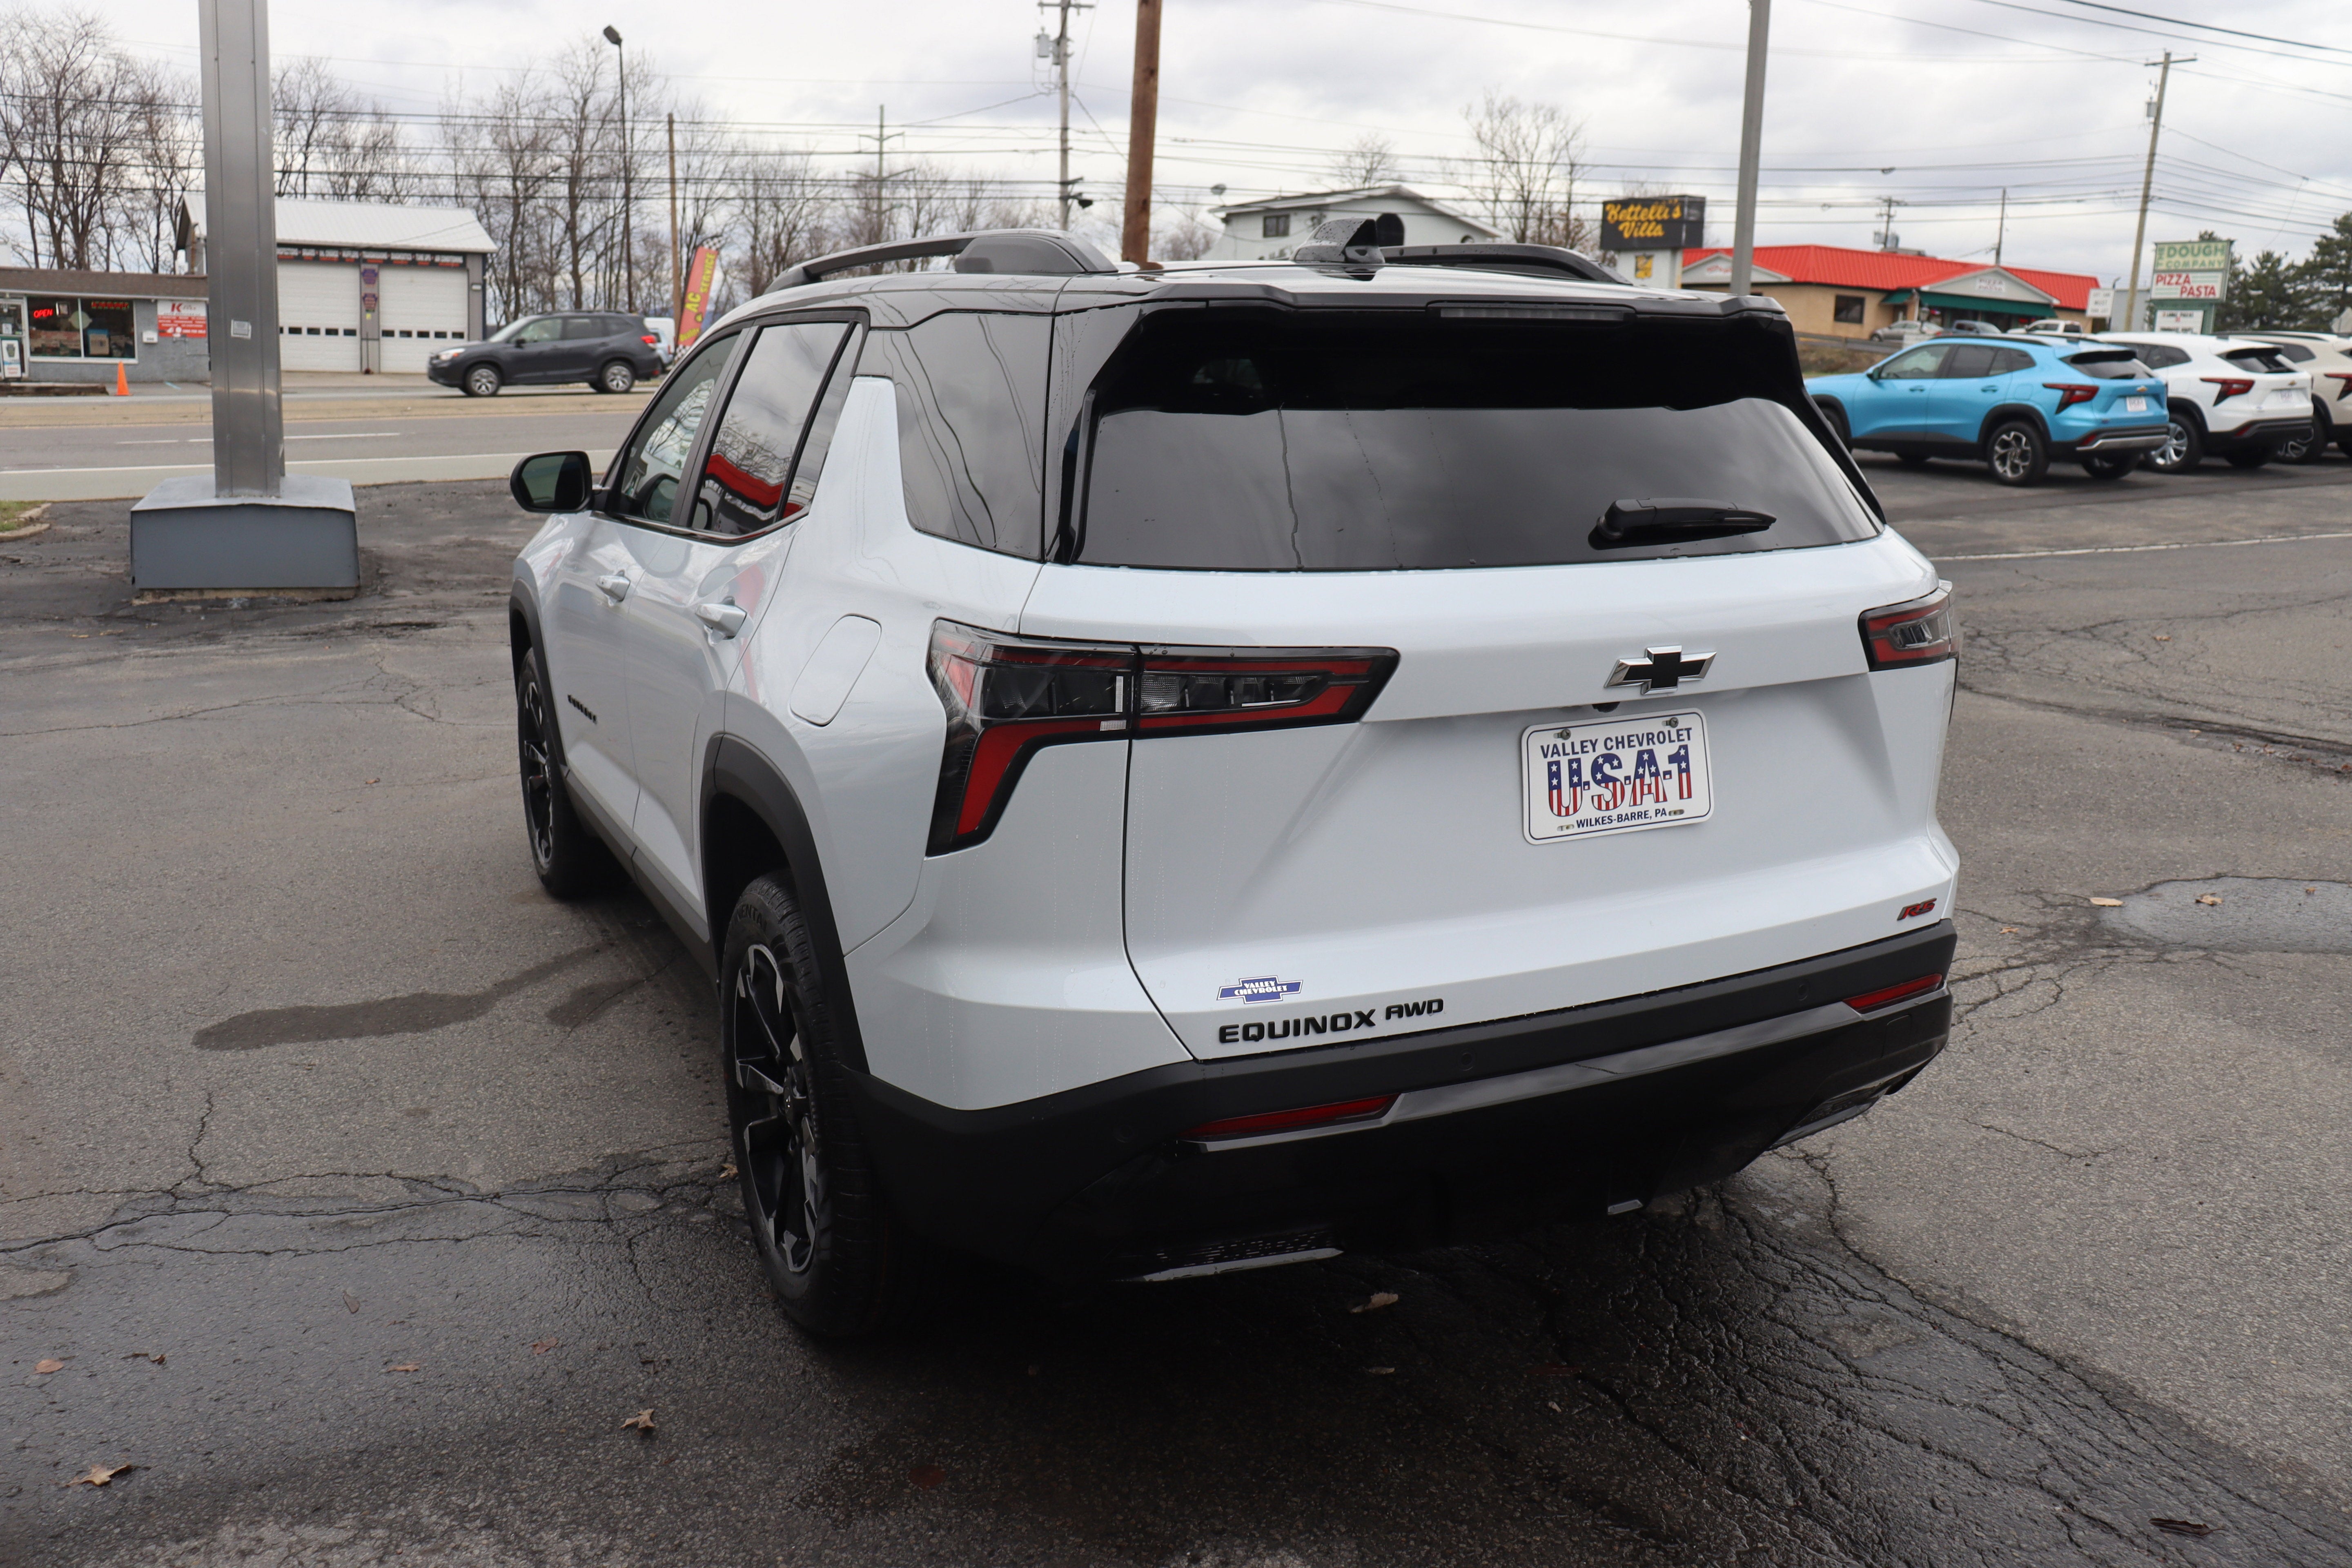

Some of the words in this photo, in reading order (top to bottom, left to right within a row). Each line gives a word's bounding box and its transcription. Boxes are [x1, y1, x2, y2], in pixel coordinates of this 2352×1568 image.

[1605, 203, 1682, 223] Bettelli's
[1618, 221, 1665, 238] Villa
[2167, 245, 2225, 258] DOUGH
[2166, 260, 2224, 269] COMPANY
[2156, 273, 2191, 286] PIZZA
[2180, 285, 2216, 298] PASTA
[33, 308, 53, 318] OPEN
[1541, 739, 1598, 759] VALLEY
[1604, 727, 1693, 751] CHEVROLET
[1576, 811, 1653, 827] WILKES-BARRE,
[1655, 808, 1667, 818] PA
[1897, 898, 1937, 921] RS
[1234, 984, 1287, 996] CHEVROLET
[1243, 980, 1276, 989] VALLEY
[1219, 1009, 1376, 1043] EQUINOX
[1385, 998, 1444, 1020] AWD
